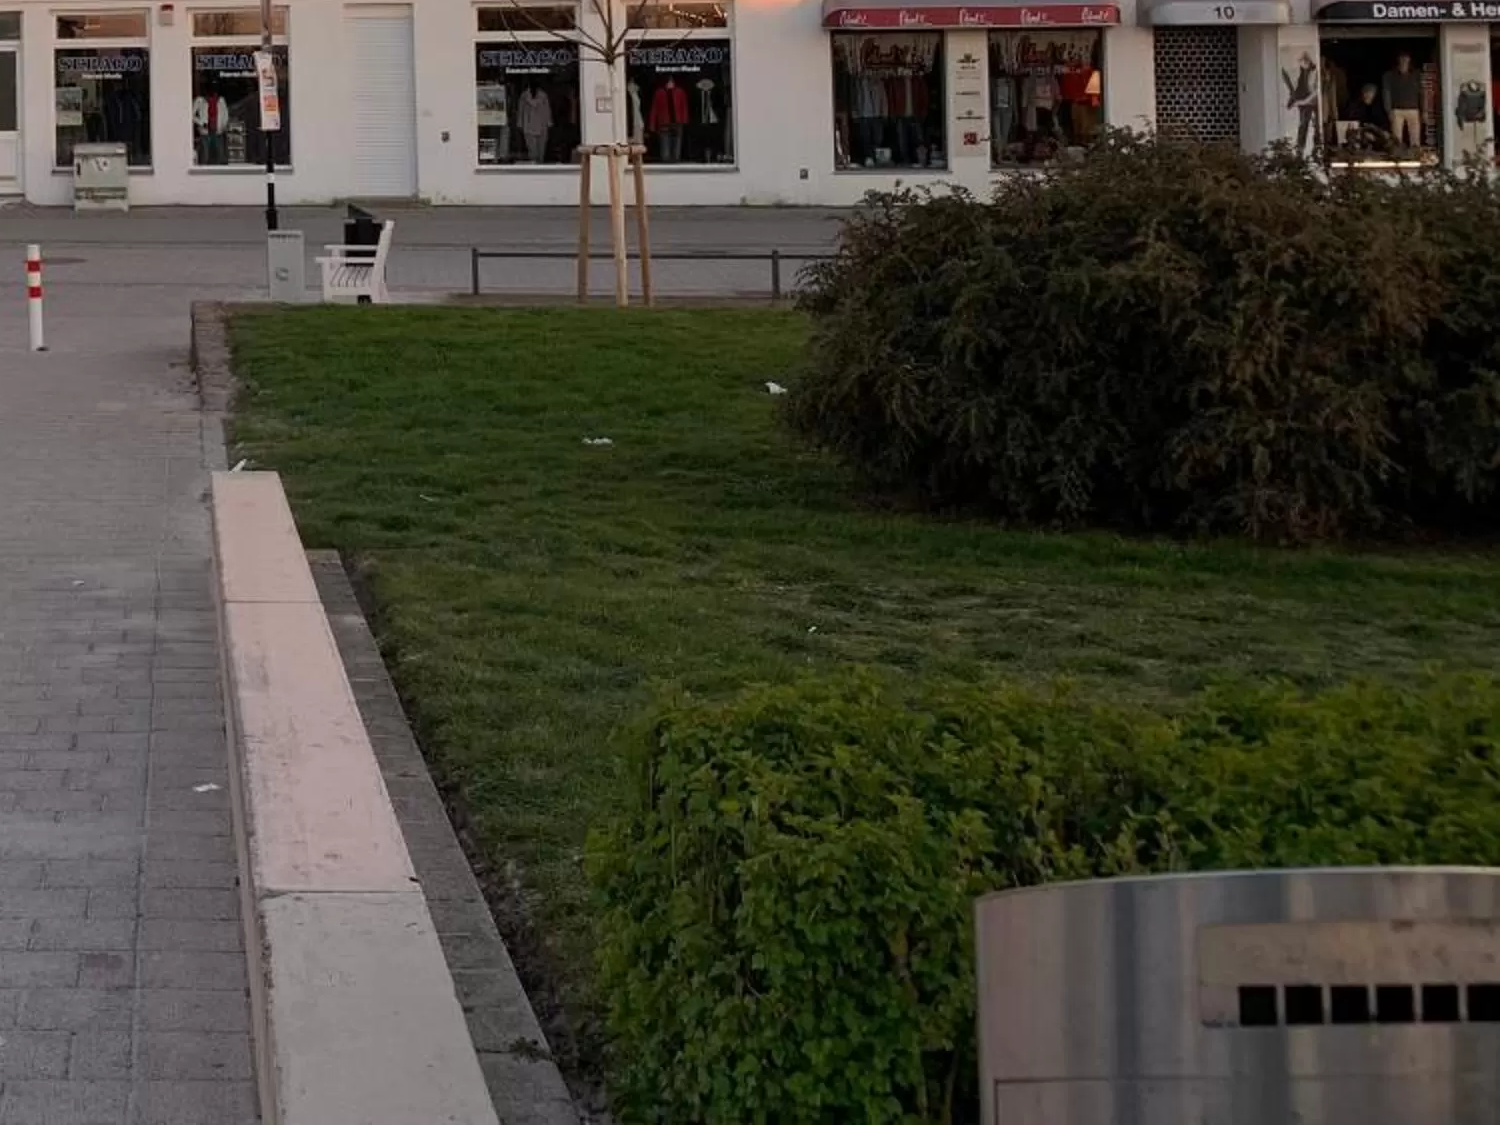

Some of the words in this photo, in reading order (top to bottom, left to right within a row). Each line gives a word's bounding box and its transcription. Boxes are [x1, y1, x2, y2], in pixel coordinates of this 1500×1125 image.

[1213, 6, 1235, 20] 10
[1373, 3, 1447, 18] Damen-
[1452, 2, 1465, 17] &
